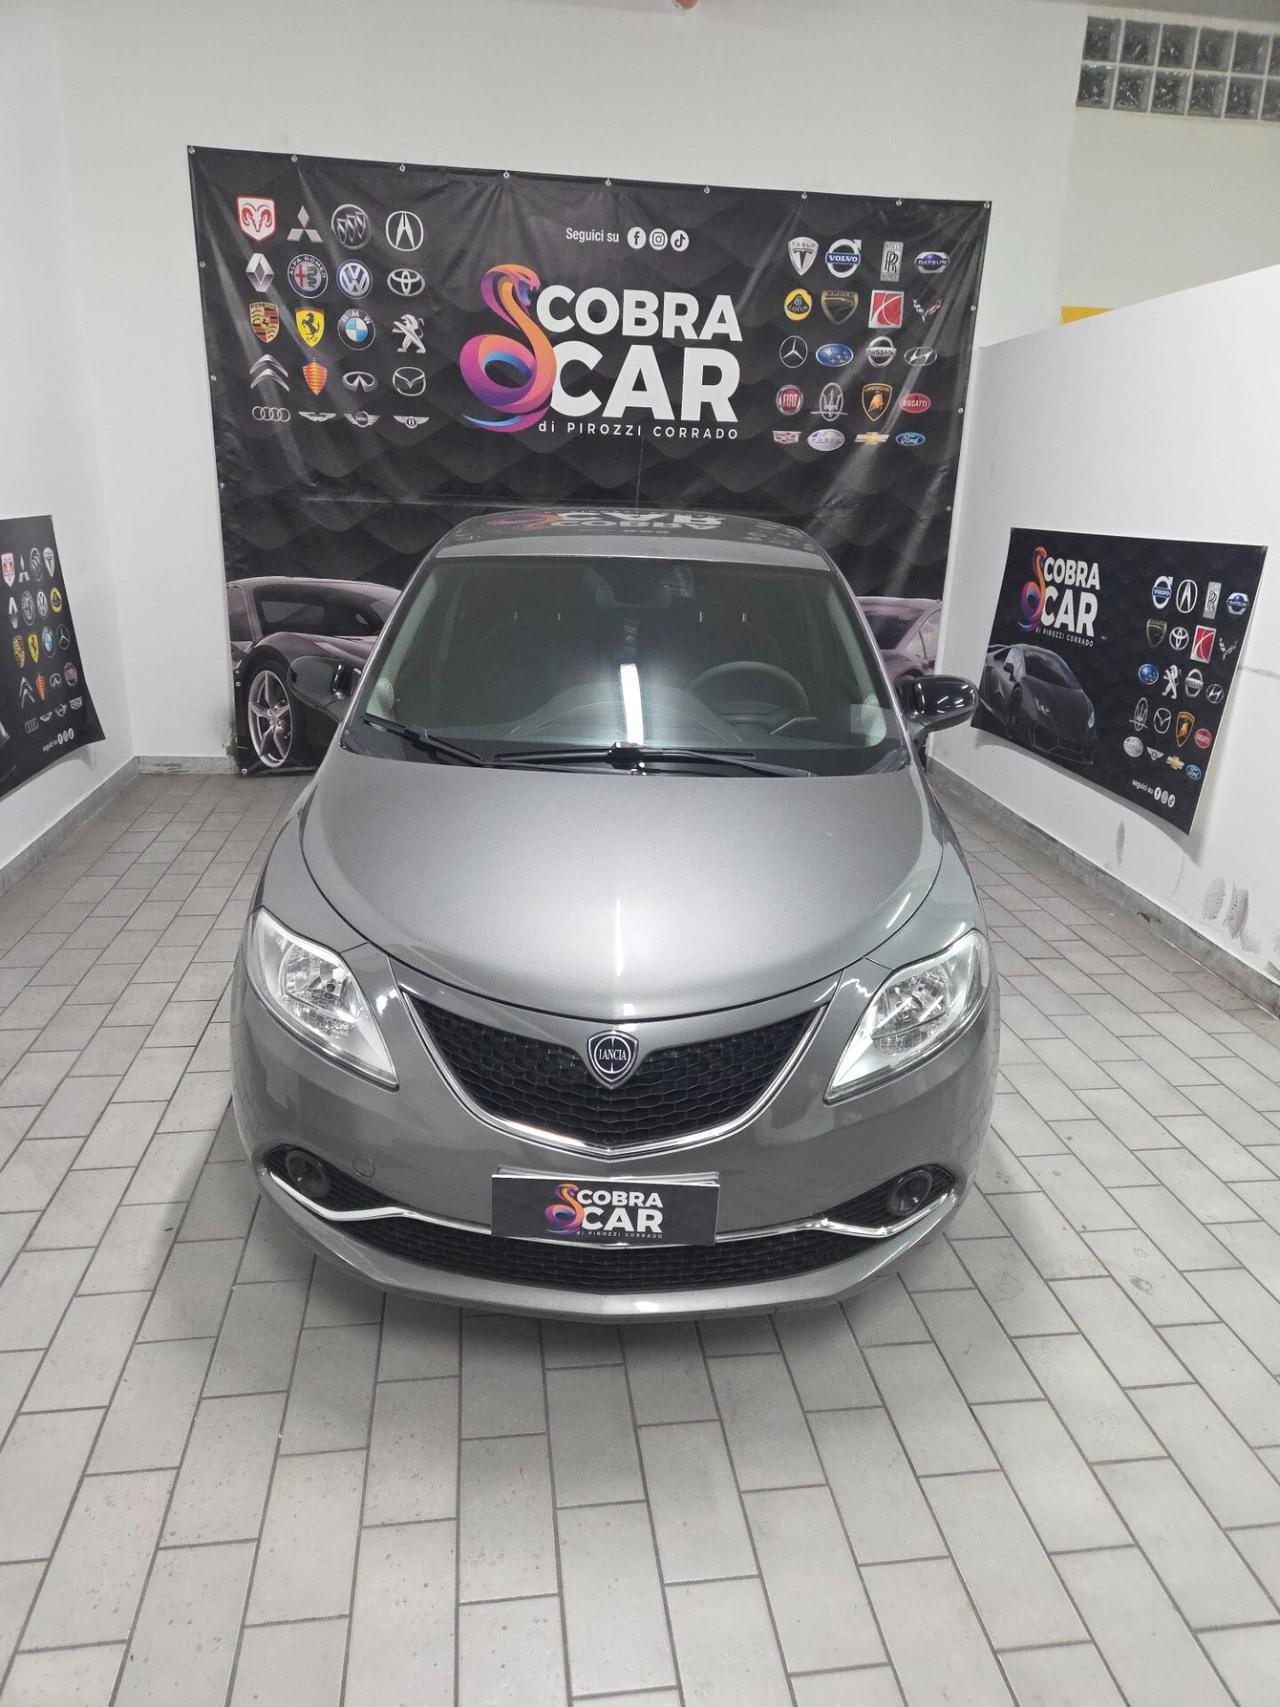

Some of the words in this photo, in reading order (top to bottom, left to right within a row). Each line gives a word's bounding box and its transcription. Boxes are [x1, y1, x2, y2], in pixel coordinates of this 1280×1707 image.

[566, 227, 604, 243] Seguici
[606, 232, 620, 243] su
[827, 254, 858, 263] VOLVO
[536, 284, 743, 342] COBRA
[550, 340, 741, 423] CAR
[782, 393, 798, 408] FIAT
[902, 399, 929, 408] BUGATTI
[538, 421, 555, 433] di
[567, 422, 642, 437] PIROZZI
[653, 426, 739, 440] CORRADO
[1043, 557, 1101, 591] COBRA
[1040, 585, 1099, 638] CAR
[598, 1048, 628, 1062] LANCIA
[576, 1189, 664, 1209] COBRA
[581, 1206, 664, 1233] CAR
